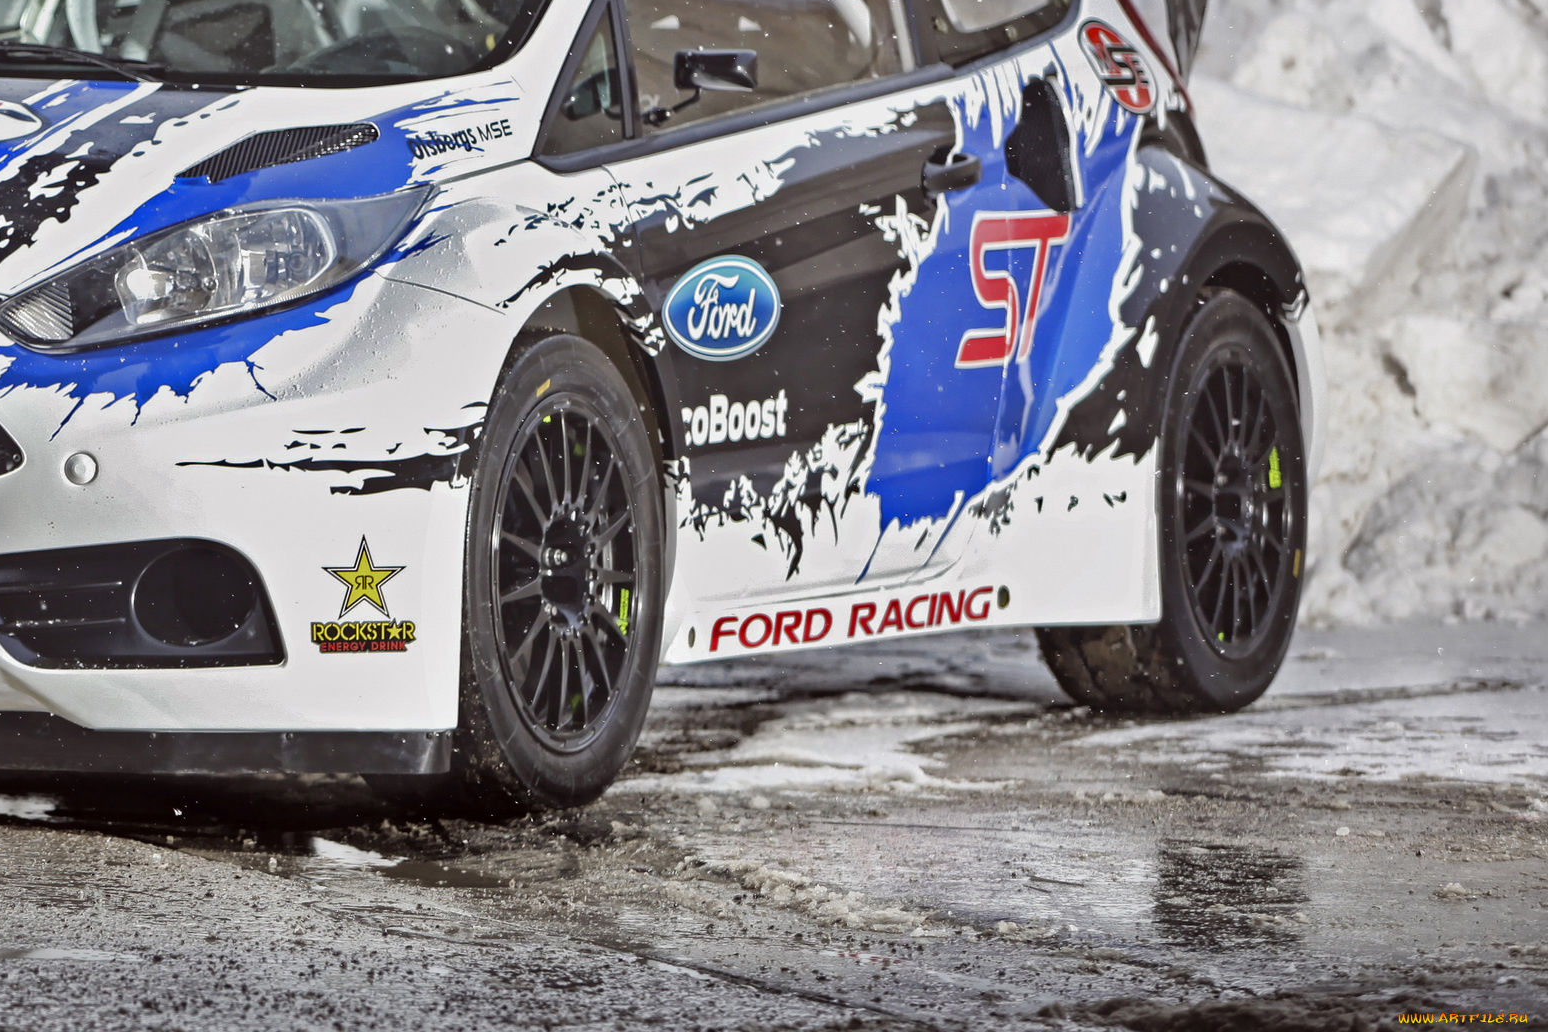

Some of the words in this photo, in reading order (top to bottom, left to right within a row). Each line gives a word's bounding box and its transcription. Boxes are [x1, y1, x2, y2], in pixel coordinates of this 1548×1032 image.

[475, 118, 514, 143] MSE
[686, 273, 757, 341] Ford
[954, 208, 1074, 370] ST
[320, 641, 366, 652] ENERGY
[371, 640, 407, 651] DRINK
[708, 607, 833, 653] FORD
[846, 585, 994, 638] RACING
